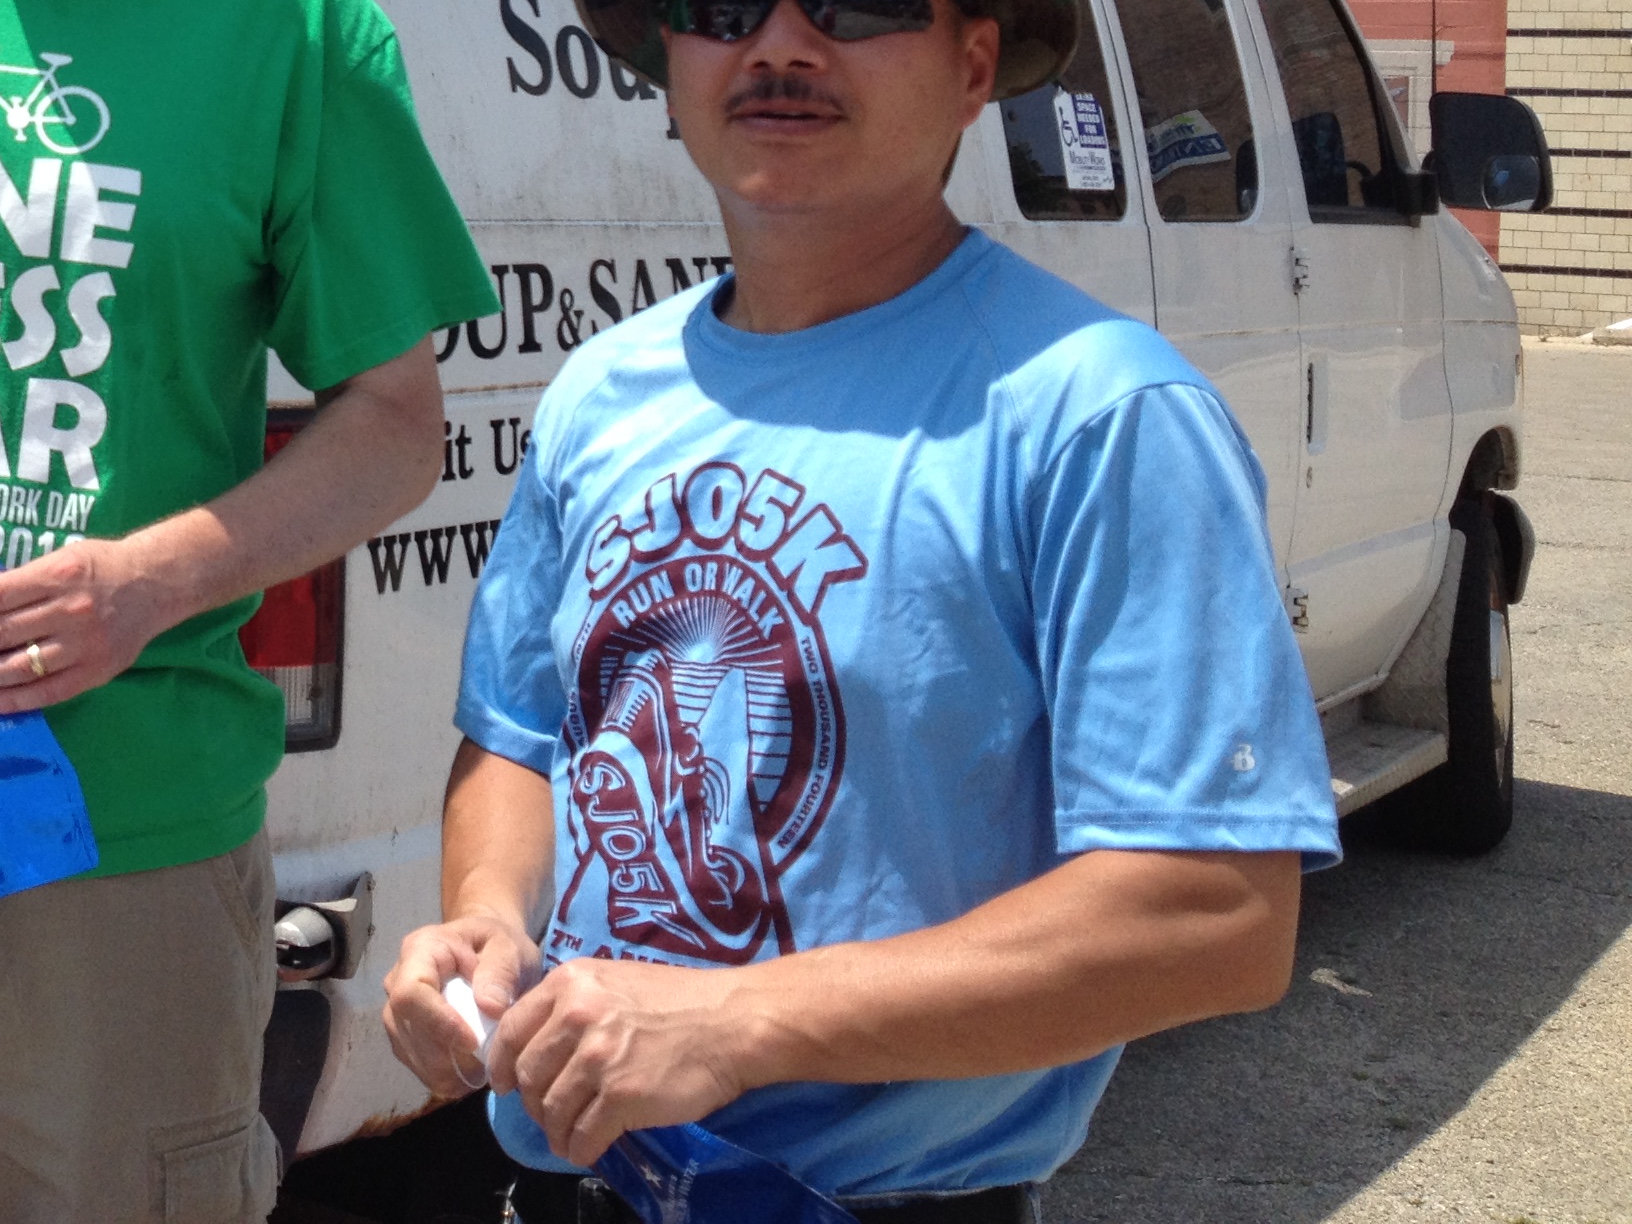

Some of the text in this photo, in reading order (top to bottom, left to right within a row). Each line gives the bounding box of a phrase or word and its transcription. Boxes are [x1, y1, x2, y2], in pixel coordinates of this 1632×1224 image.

[441, 421, 474, 482] it
[45, 490, 95, 531] DAY
[611, 563, 784, 637] RUN OR WALK
[777, 636, 831, 849] TWO THOUSAND FOURTEEN
[549, 928, 584, 952] 7TH
